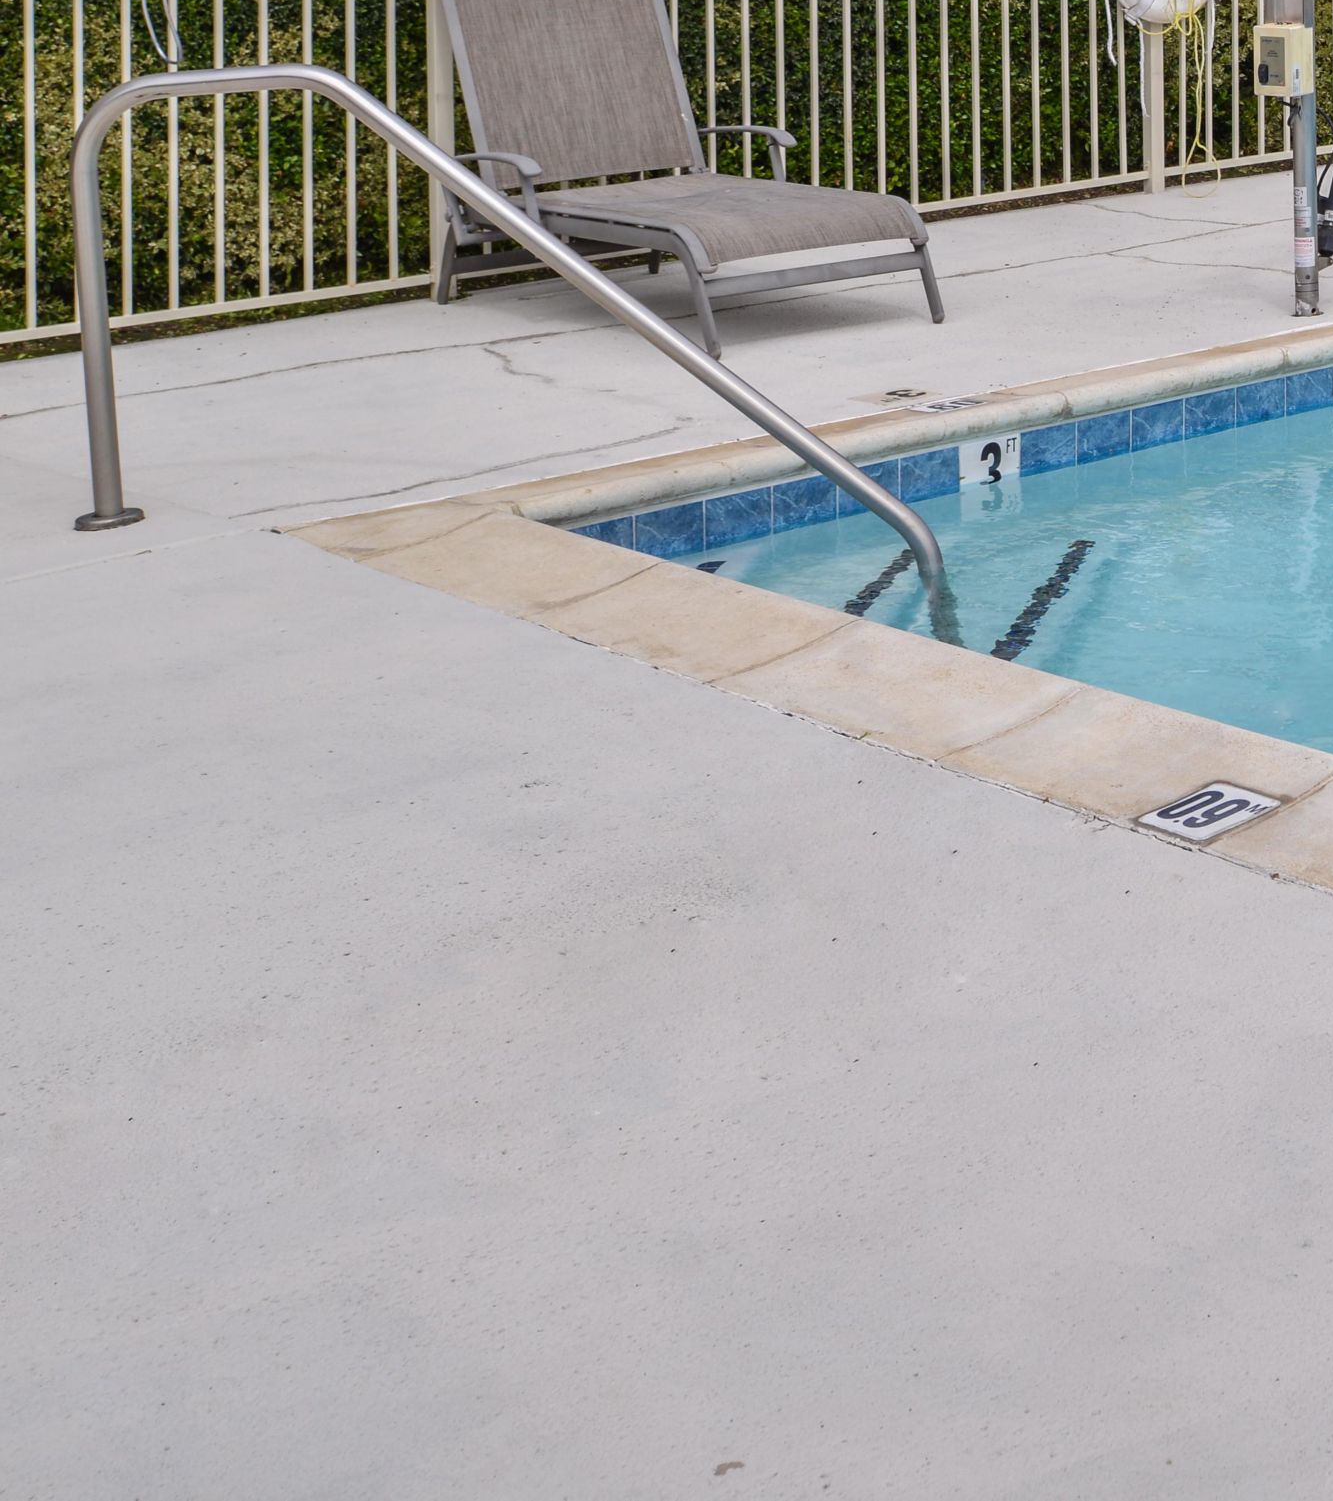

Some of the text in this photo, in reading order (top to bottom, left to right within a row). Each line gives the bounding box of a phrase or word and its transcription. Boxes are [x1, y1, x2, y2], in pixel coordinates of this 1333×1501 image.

[979, 437, 1017, 485] 3 FT
[1156, 790, 1251, 828] 0.9
